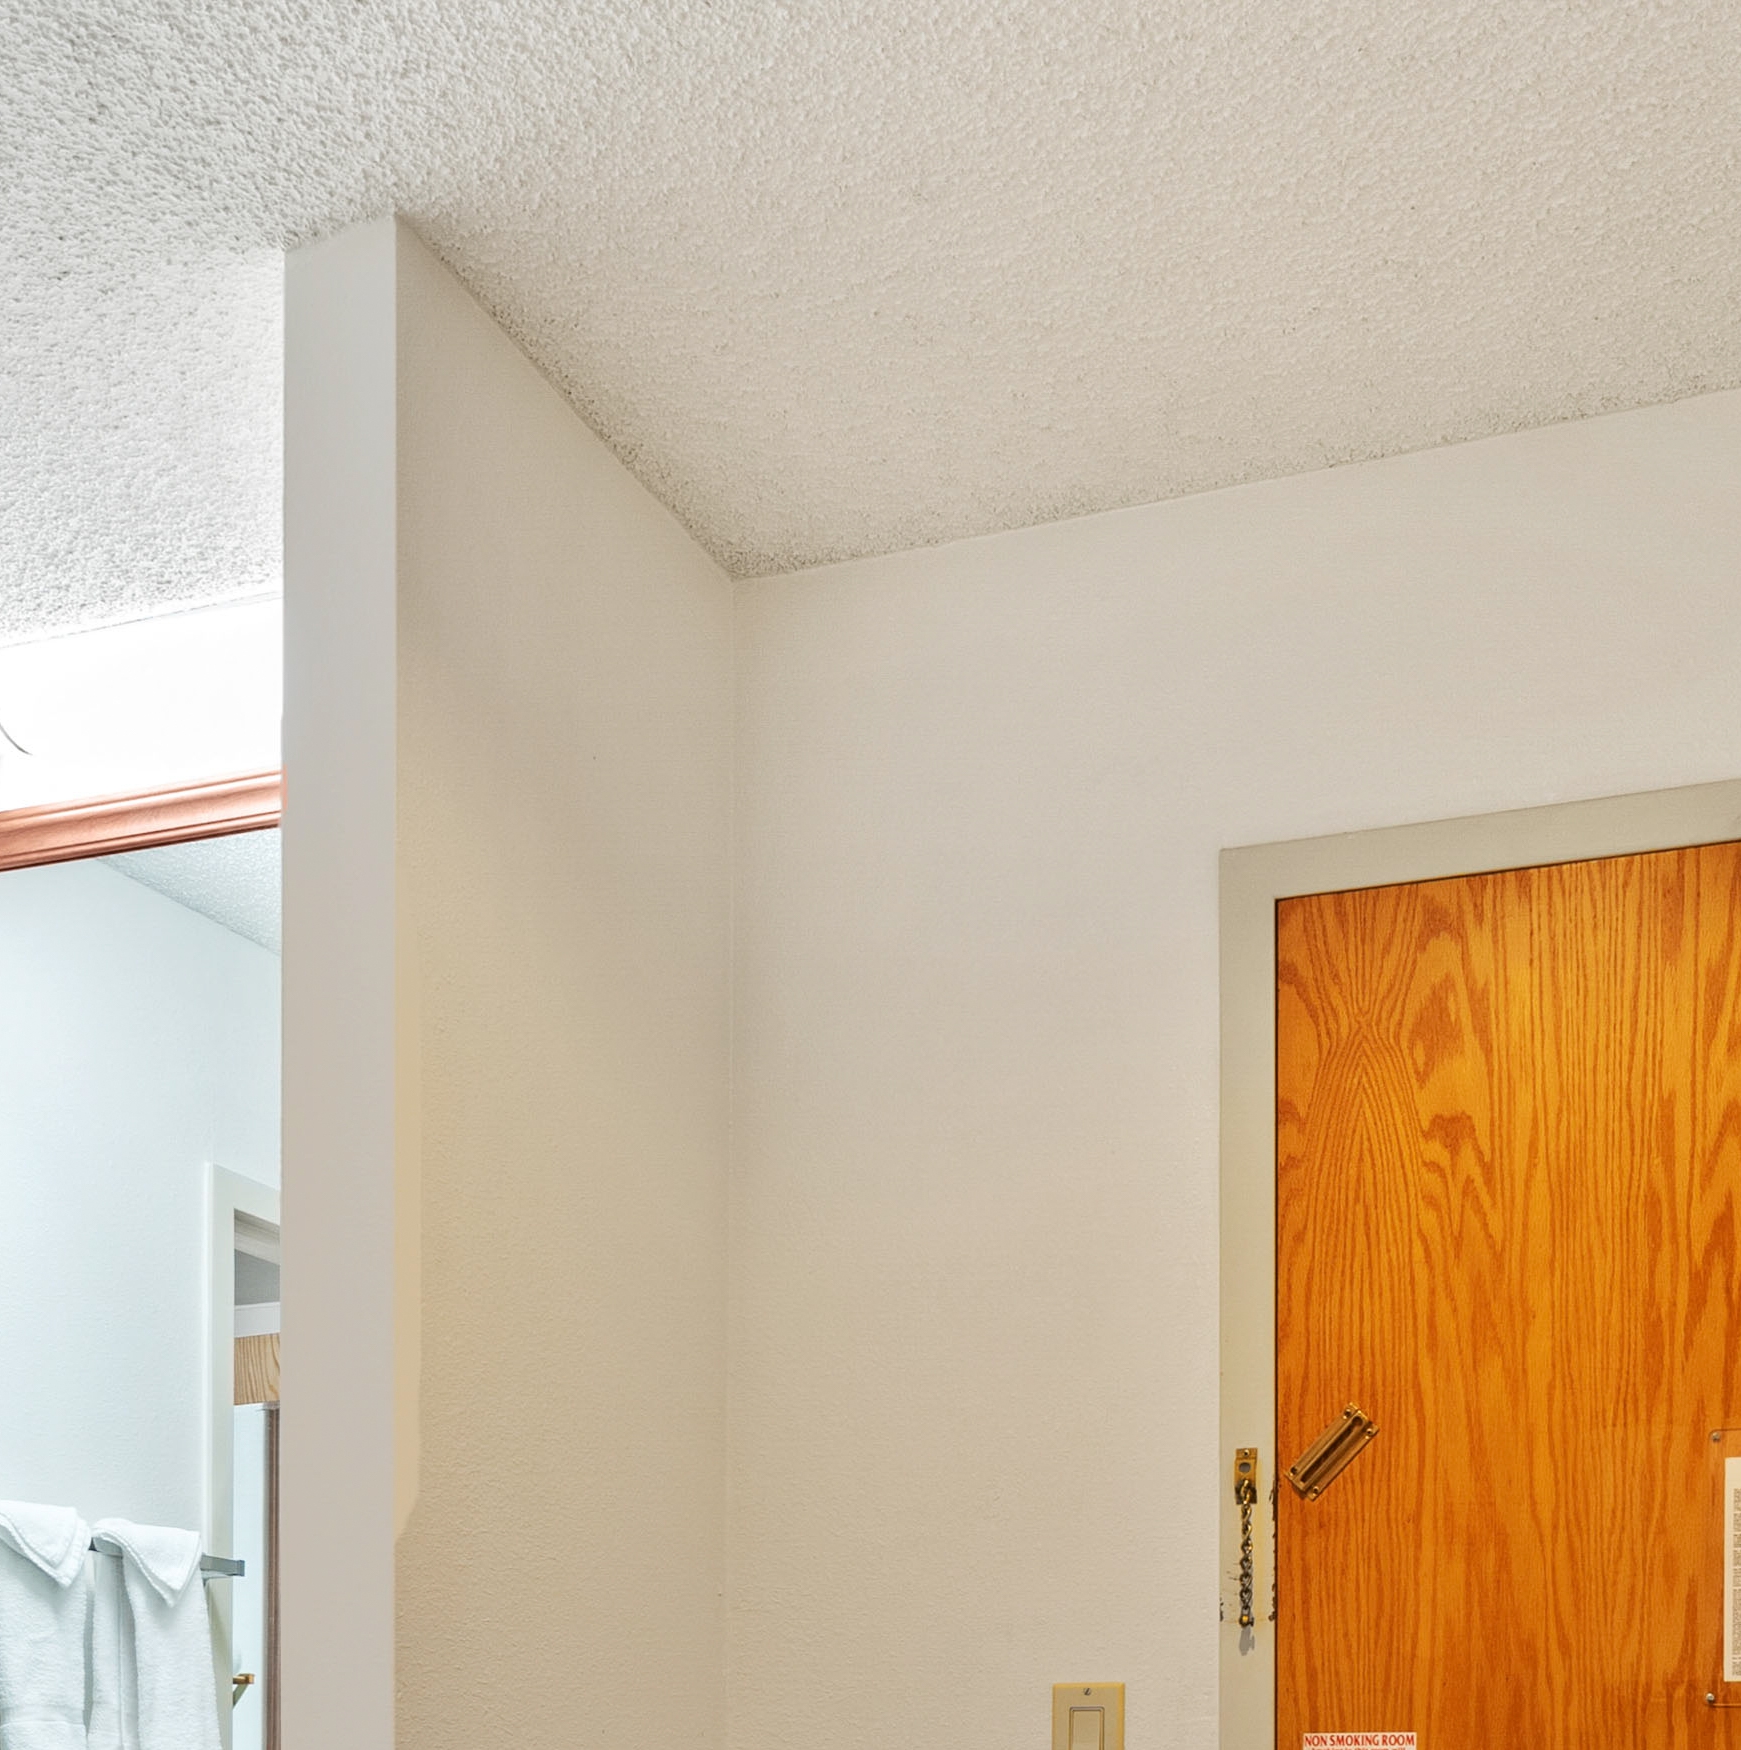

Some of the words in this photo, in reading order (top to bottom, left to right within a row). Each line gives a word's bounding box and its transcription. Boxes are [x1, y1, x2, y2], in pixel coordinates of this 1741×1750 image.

[1304, 1735, 1328, 1747] NON
[1329, 1734, 1380, 1746] SMOKING
[1382, 1734, 1415, 1746] ROOM
